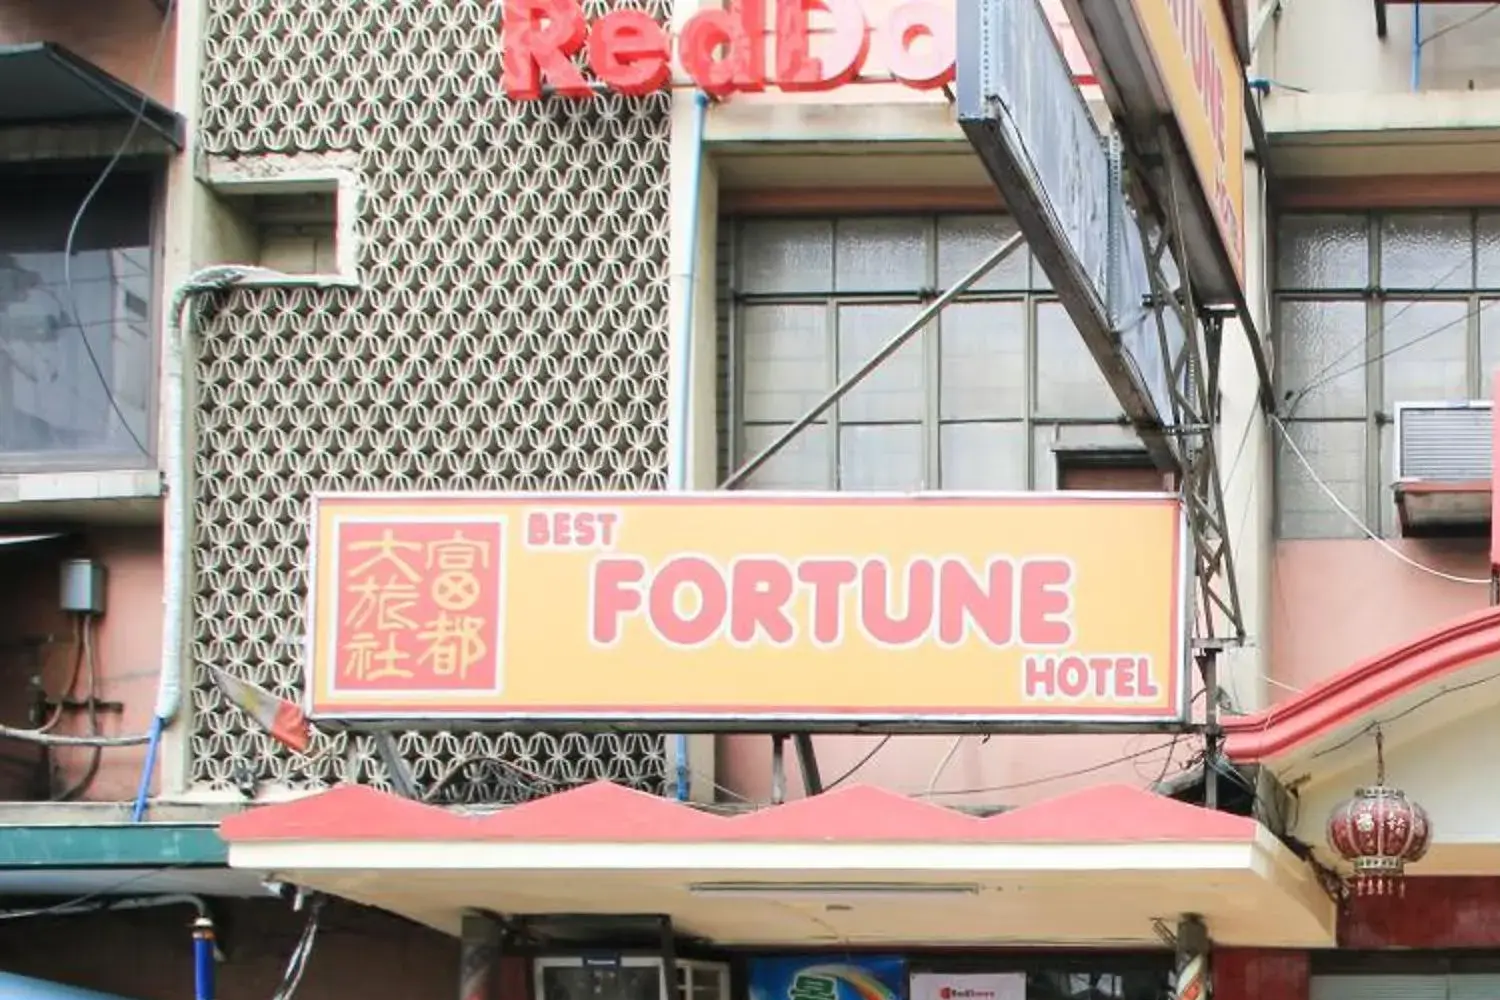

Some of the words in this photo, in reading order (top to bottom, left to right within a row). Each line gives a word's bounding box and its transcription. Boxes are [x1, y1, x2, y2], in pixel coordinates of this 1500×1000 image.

[527, 512, 617, 545] BEST
[593, 557, 1072, 645] FORTUNE
[1024, 657, 1158, 697] HOTEL
